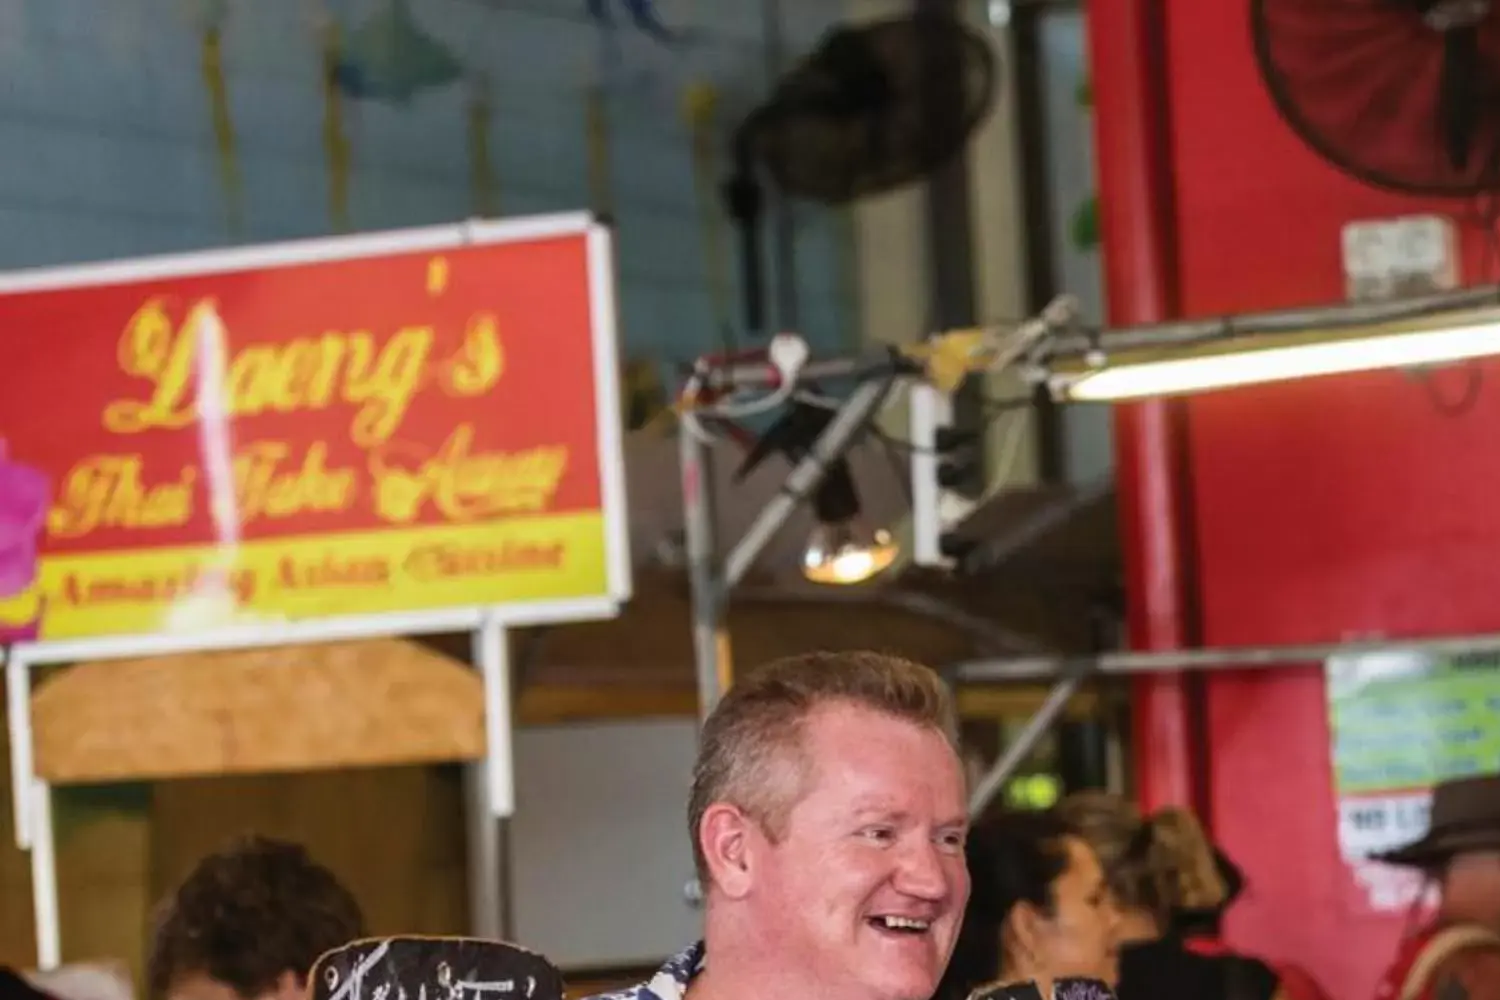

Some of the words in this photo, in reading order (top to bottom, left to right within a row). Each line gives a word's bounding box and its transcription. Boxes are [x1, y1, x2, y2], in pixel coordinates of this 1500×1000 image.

[48, 456, 192, 534] Thai
[228, 440, 356, 524] Take
[277, 551, 392, 590] Asian
